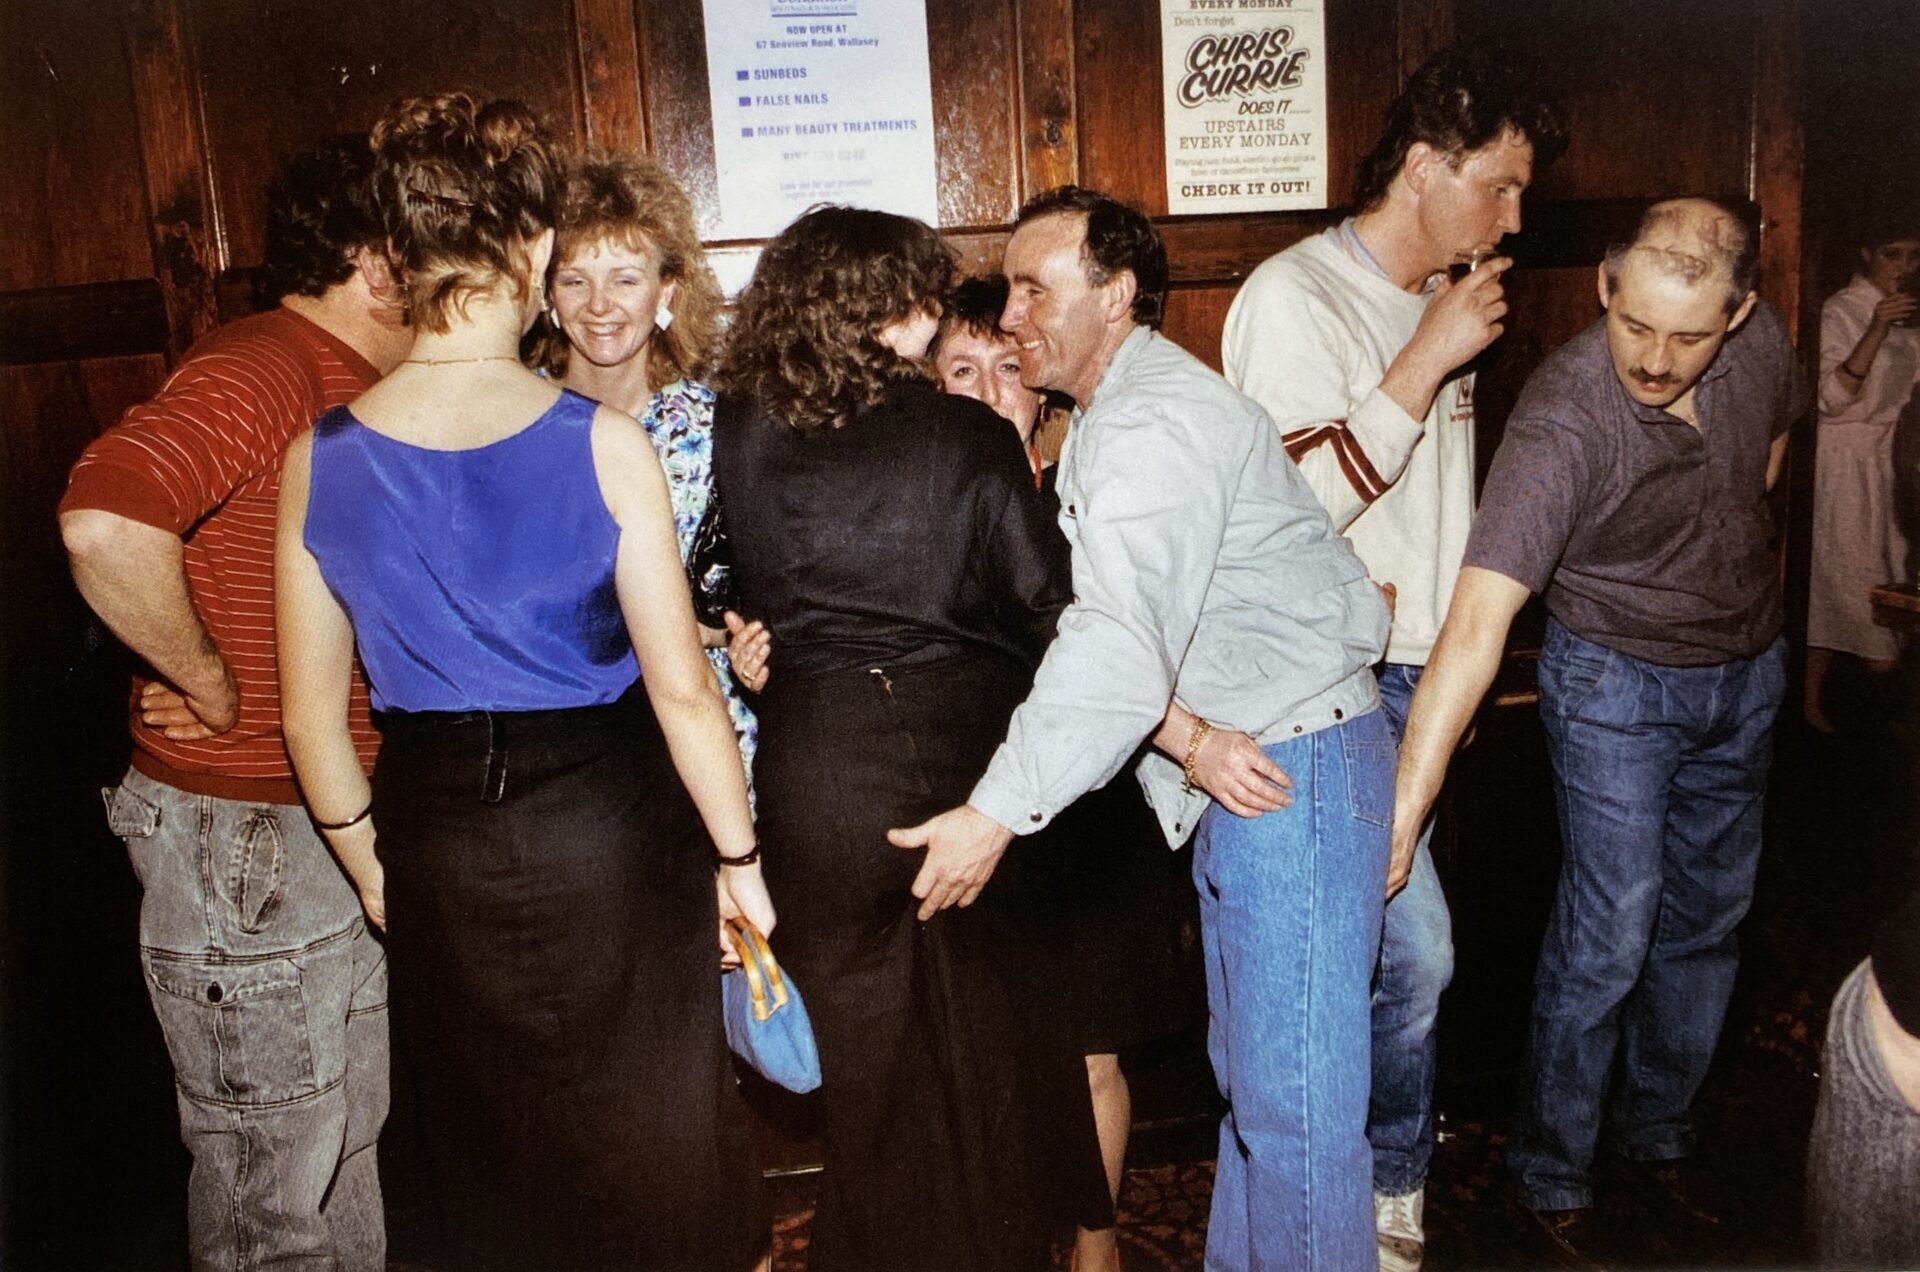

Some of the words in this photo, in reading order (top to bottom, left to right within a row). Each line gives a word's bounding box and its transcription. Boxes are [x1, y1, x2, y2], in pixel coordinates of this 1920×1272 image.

[1190, 0, 1233, 9] EVERY
[1238, 0, 1293, 8] MONDAY
[786, 26, 807, 34] NOW
[809, 25, 833, 33] OPEN
[835, 24, 847, 33] AT
[1174, 17, 1201, 26] Don't
[1204, 16, 1235, 27] forget
[770, 39, 808, 48] Seaview
[838, 37, 879, 47] Wallasey
[1188, 27, 1291, 71] CHRIS
[754, 67, 807, 80] SUNBEDS
[1181, 51, 1307, 104] CURRIE
[756, 95, 791, 106] FALSE
[794, 93, 829, 105] NAILS
[1238, 100, 1275, 115] DOES
[757, 125, 791, 137] MANY
[796, 123, 838, 135] BEAUTY
[843, 119, 917, 133] TREATMENTS
[1205, 119, 1286, 134] UPSTAIRS
[1179, 136, 1234, 150] EVERY
[1240, 133, 1312, 148] MONDAY
[1181, 184, 1241, 198] CHECK
[1247, 183, 1265, 195] IT
[1270, 181, 1310, 193] OUT!
